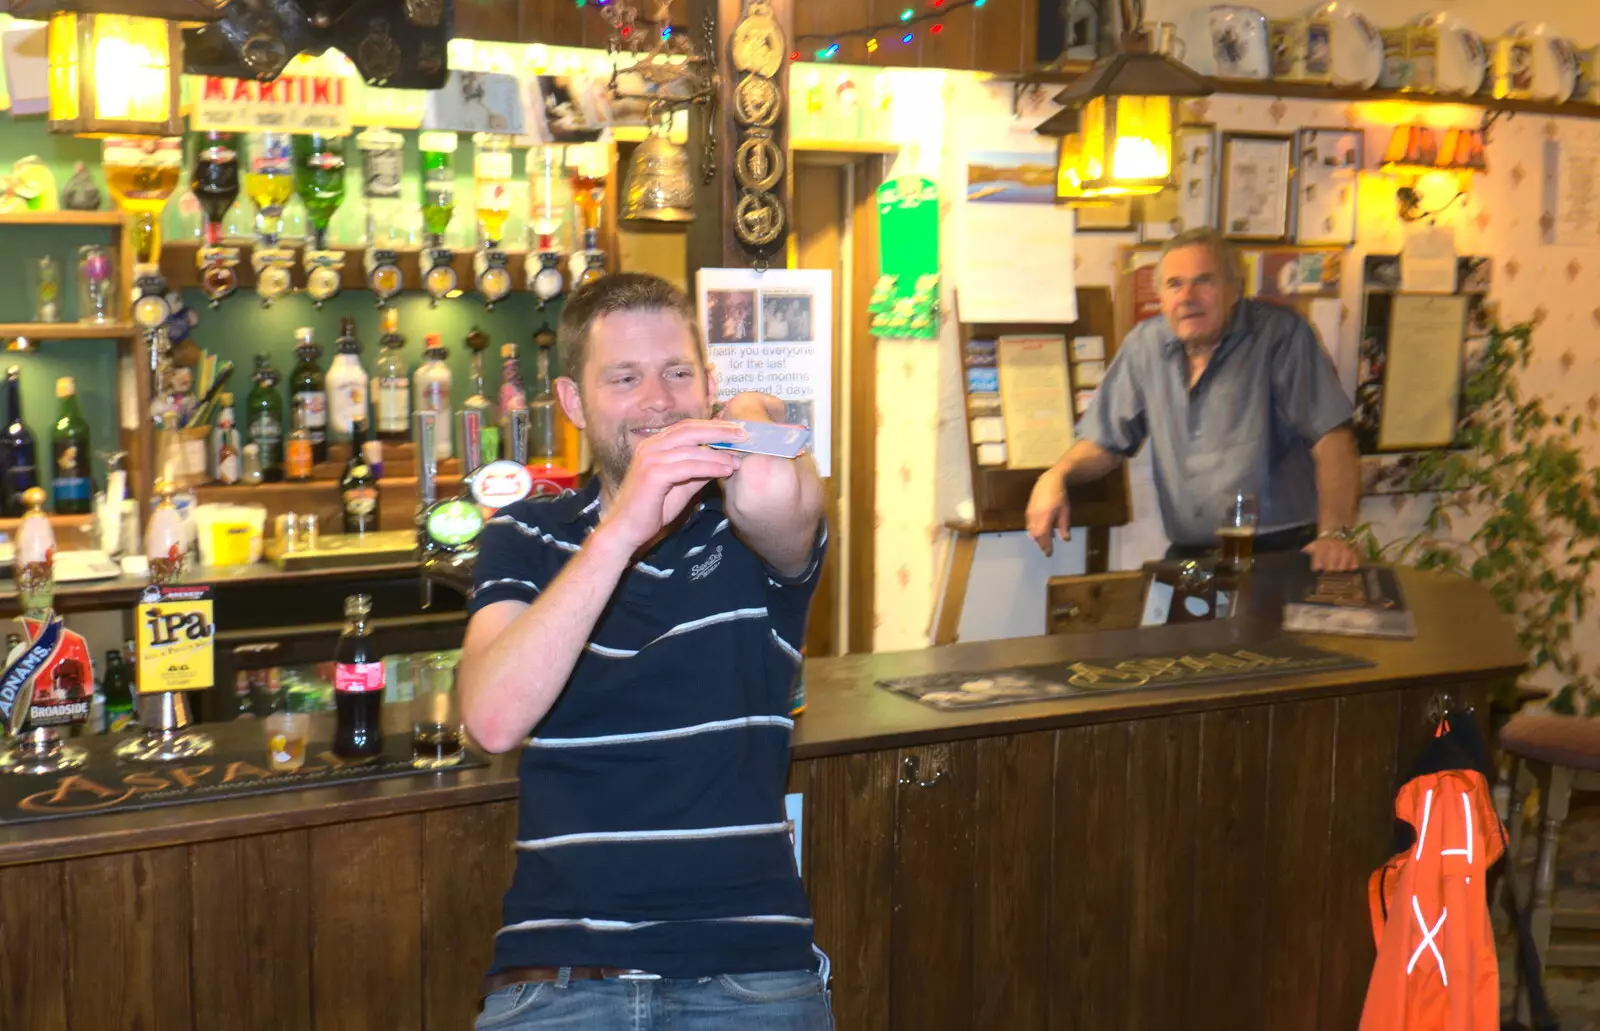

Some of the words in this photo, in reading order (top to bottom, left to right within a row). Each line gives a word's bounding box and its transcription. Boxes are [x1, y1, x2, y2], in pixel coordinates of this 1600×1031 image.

[740, 346, 759, 358] you
[762, 344, 815, 357] everyone
[729, 359, 743, 369] for
[747, 358, 764, 369] the
[767, 358, 787, 369] last
[726, 374, 754, 384] years
[768, 370, 811, 381] months
[786, 383, 814, 398] days
[0, 645, 49, 718] ADNAMS
[31, 702, 88, 719] BROADSIDE
